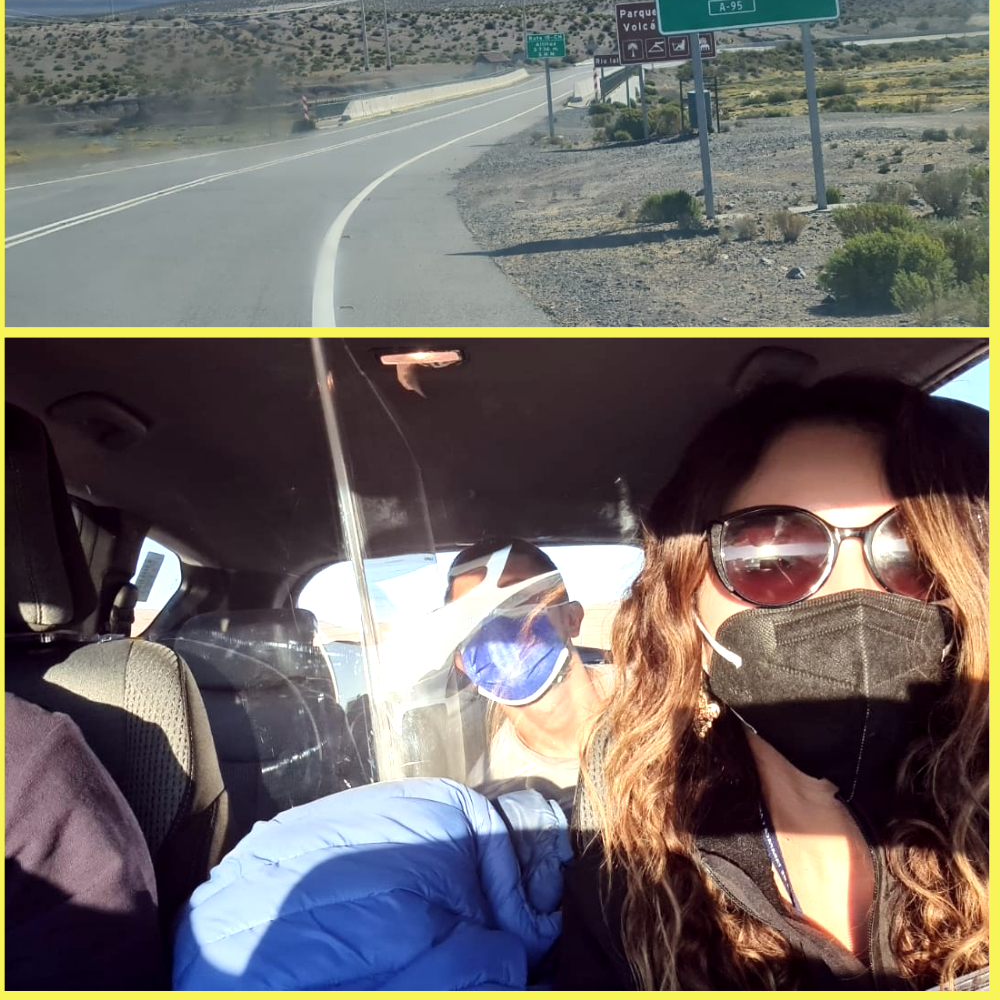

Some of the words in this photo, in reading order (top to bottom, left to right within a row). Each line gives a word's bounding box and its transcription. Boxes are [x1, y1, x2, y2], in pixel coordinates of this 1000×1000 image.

[719, 1, 743, 12] A-95
[619, 9, 657, 19] Parque
[623, 18, 656, 32] Volcá
